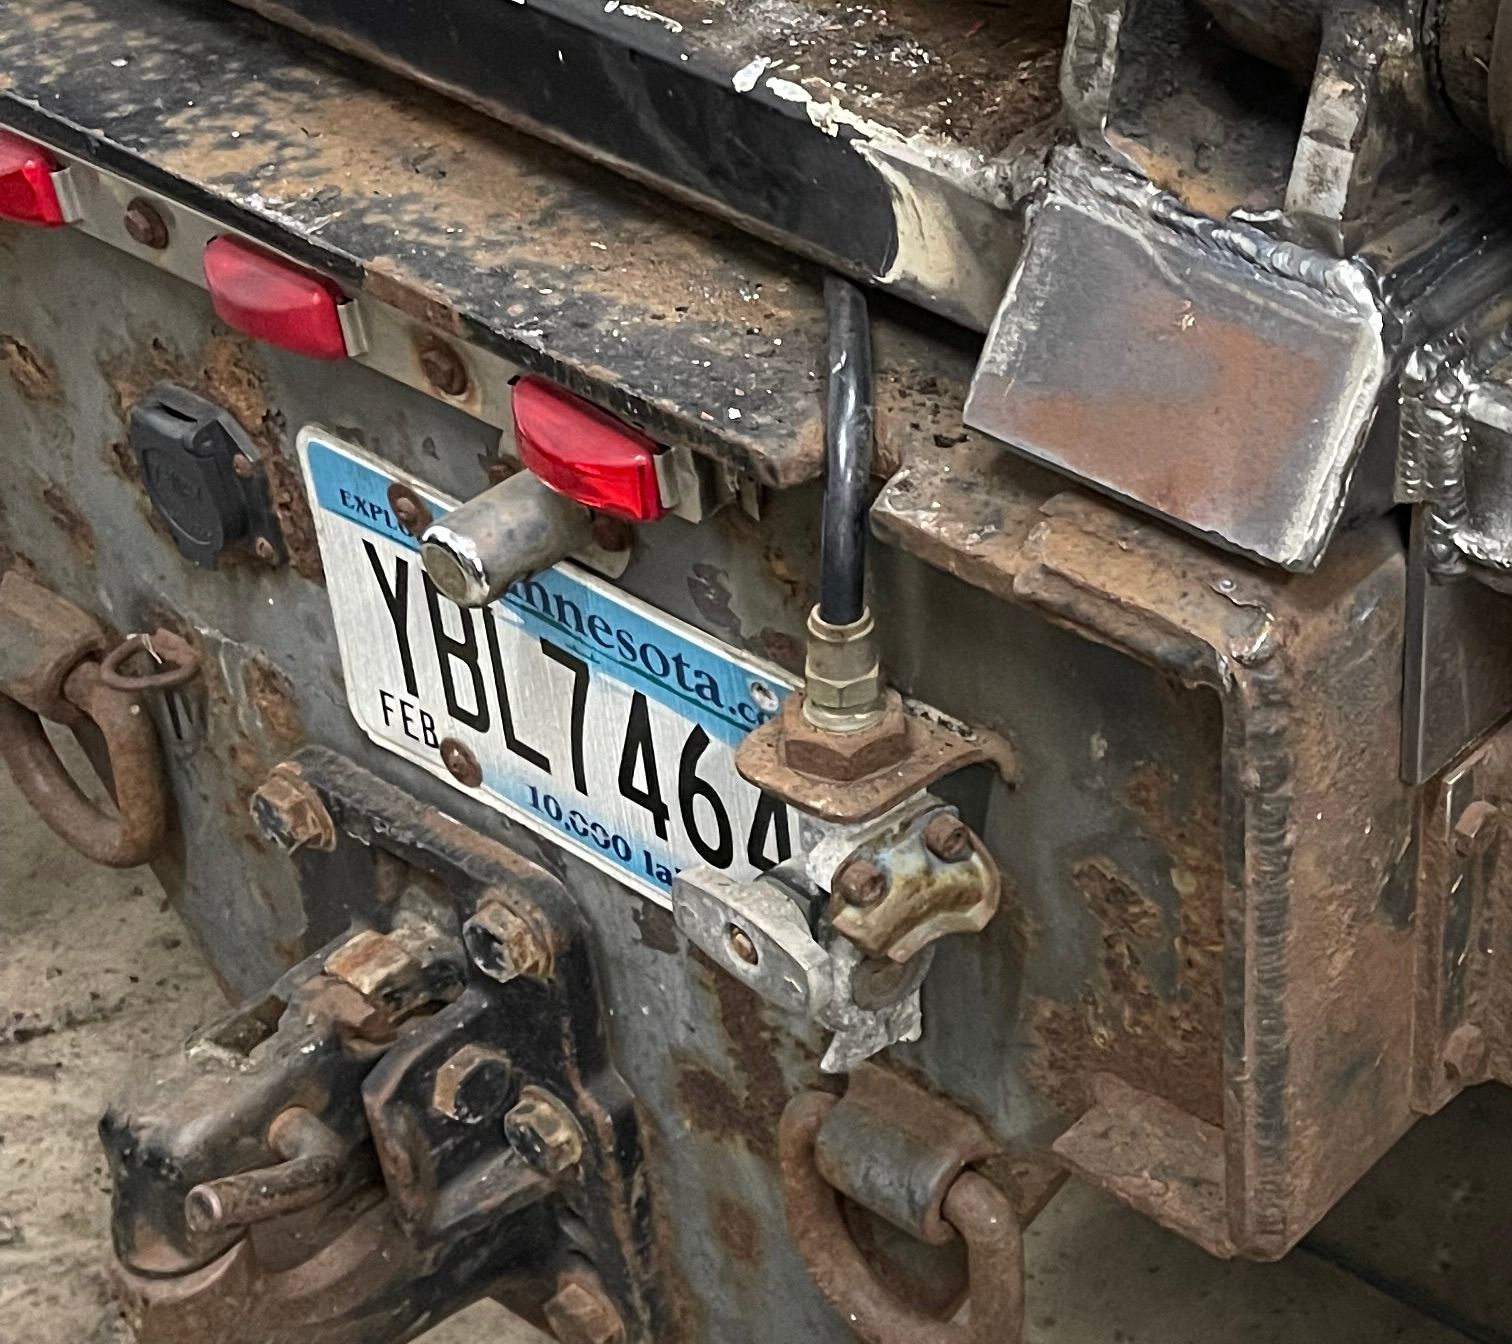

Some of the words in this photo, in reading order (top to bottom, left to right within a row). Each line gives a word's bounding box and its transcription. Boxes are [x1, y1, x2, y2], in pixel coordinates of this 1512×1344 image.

[361, 538, 792, 872] YBL7464
[379, 689, 440, 749] FEB
[643, 850, 682, 887] la
